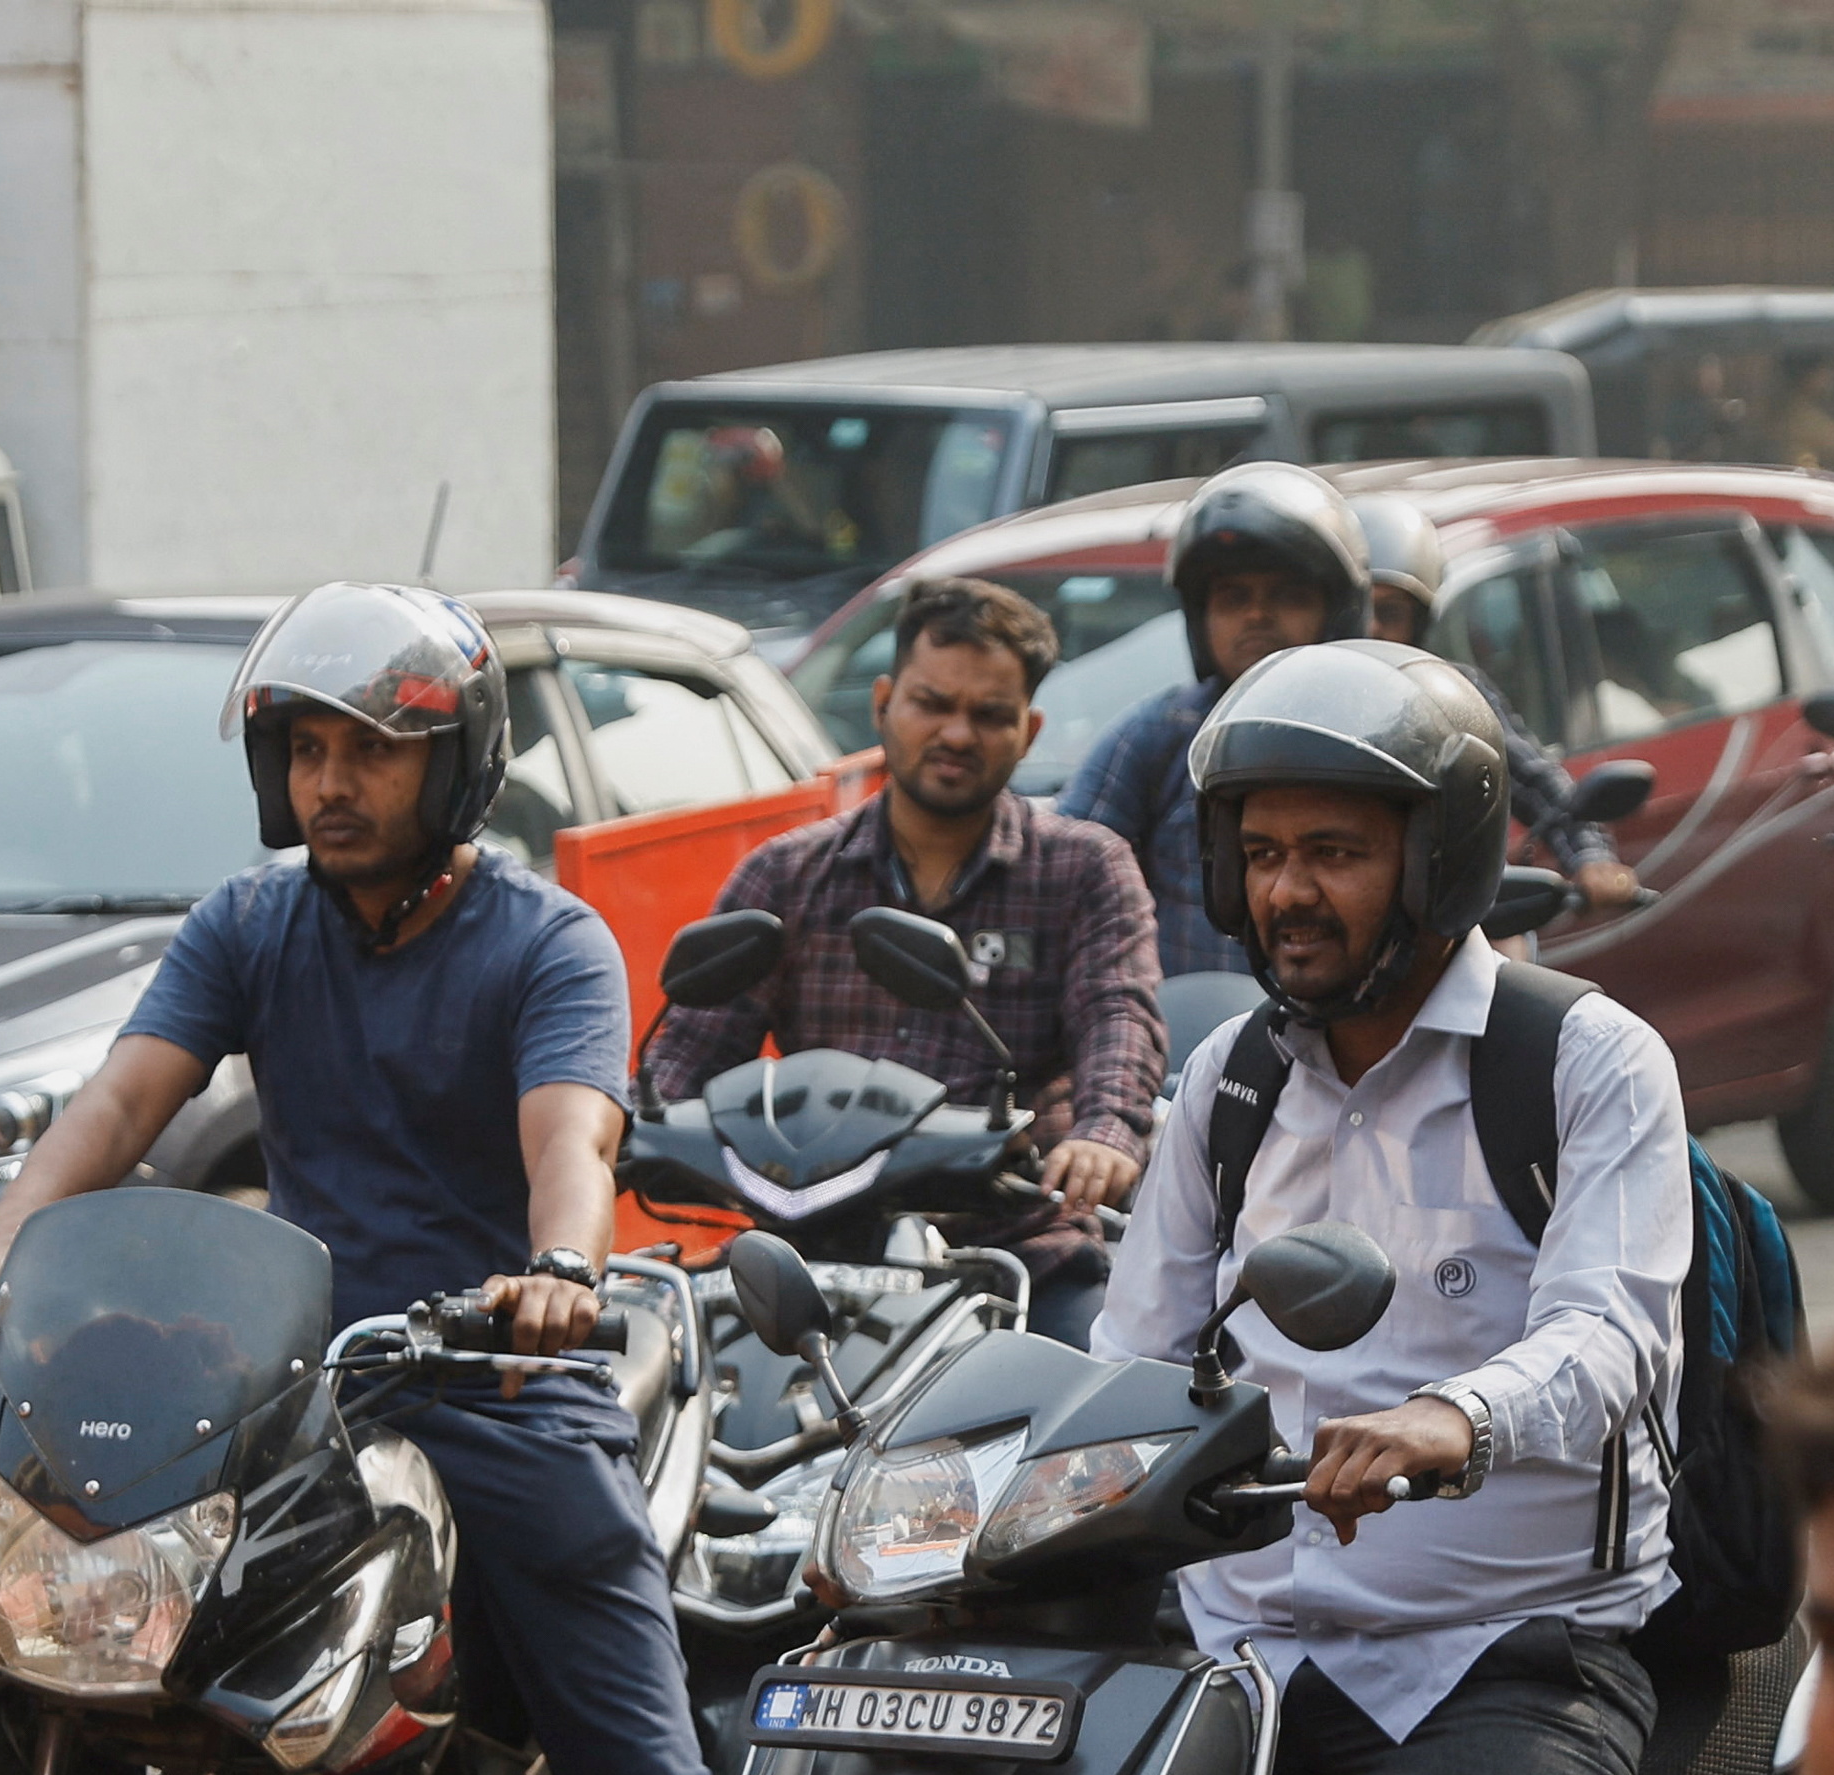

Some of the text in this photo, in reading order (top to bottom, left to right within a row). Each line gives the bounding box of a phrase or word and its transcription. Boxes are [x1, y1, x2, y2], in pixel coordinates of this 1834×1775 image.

[1217, 1075, 1258, 1105] MARVEL
[80, 1420, 132, 1440] Hero
[904, 1655, 1012, 1678] HONDA
[799, 1686, 1062, 1740] MH 03CU 9872
